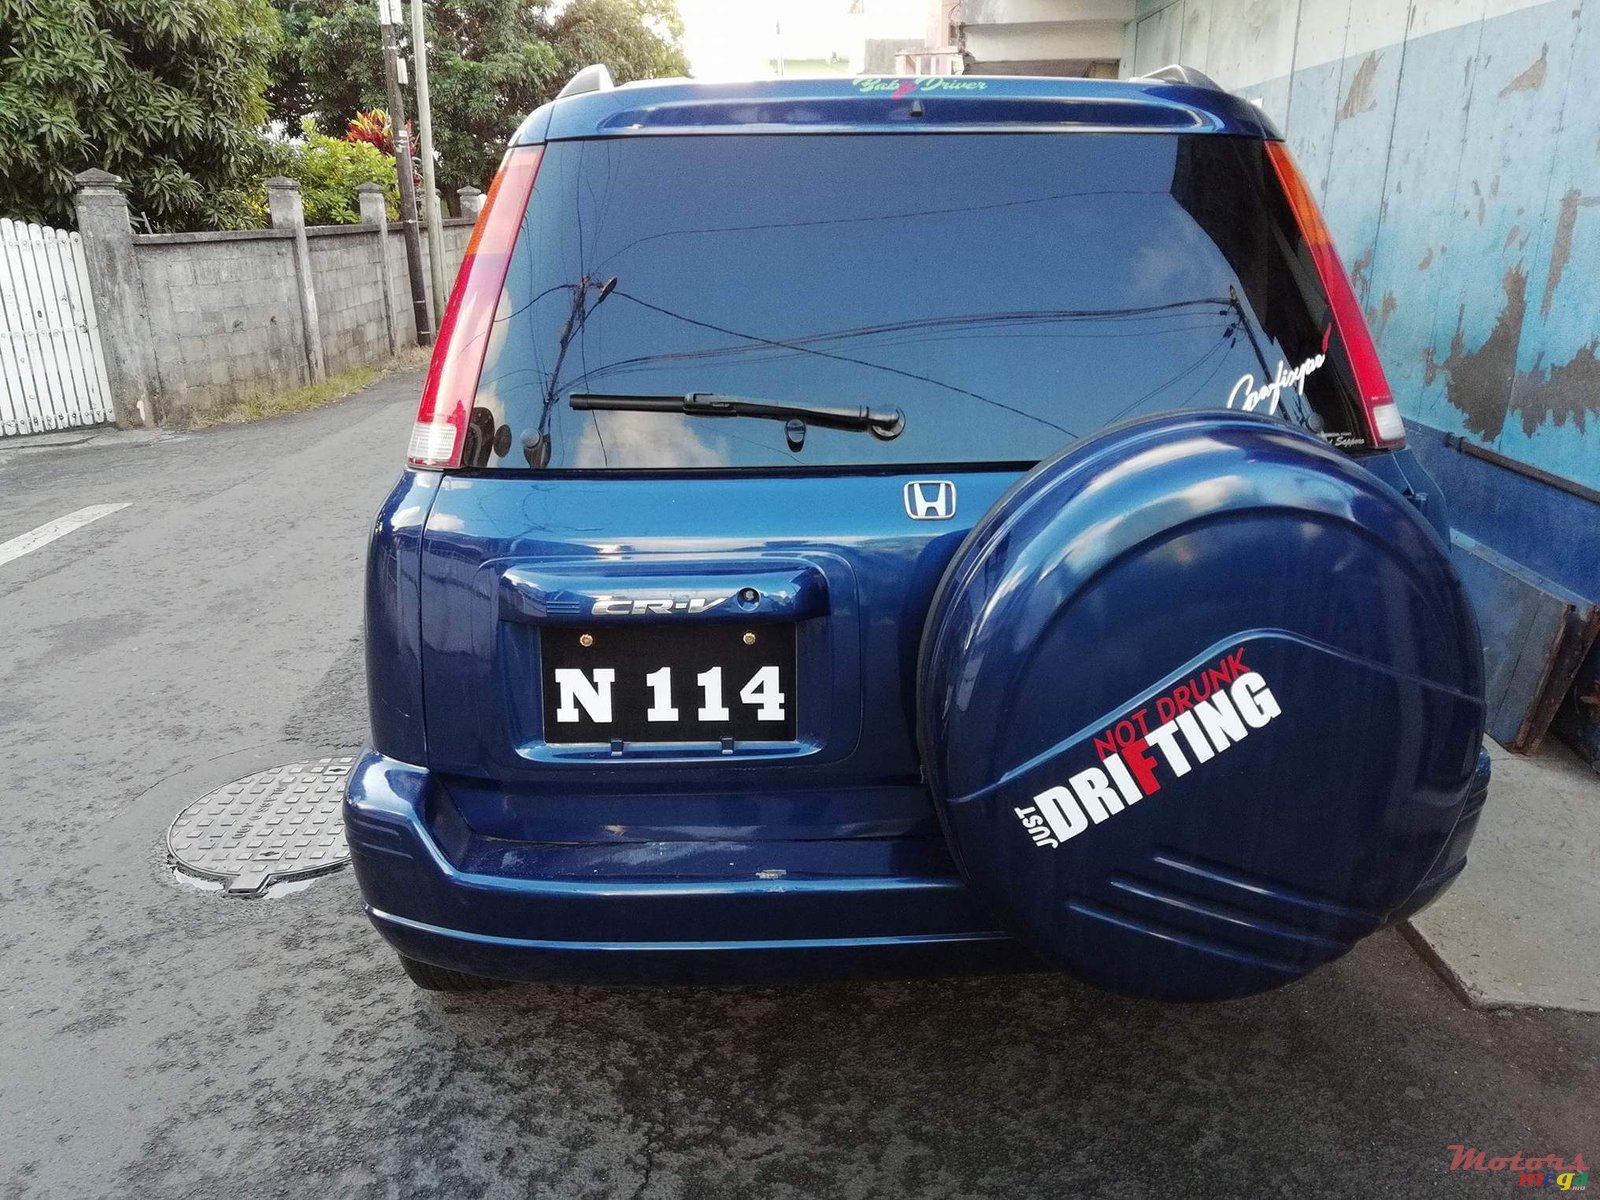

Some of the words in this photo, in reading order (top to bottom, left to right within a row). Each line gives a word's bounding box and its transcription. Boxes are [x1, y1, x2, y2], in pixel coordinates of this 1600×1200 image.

[914, 76, 988, 91] Driver
[591, 598, 730, 615] CR-V
[555, 668, 615, 723] N
[646, 666, 785, 722] 114
[1093, 709, 1150, 760] NOT
[1156, 647, 1250, 723] DRUNK
[1033, 671, 1282, 843] DRIFTING
[1014, 805, 1059, 849] JUST
